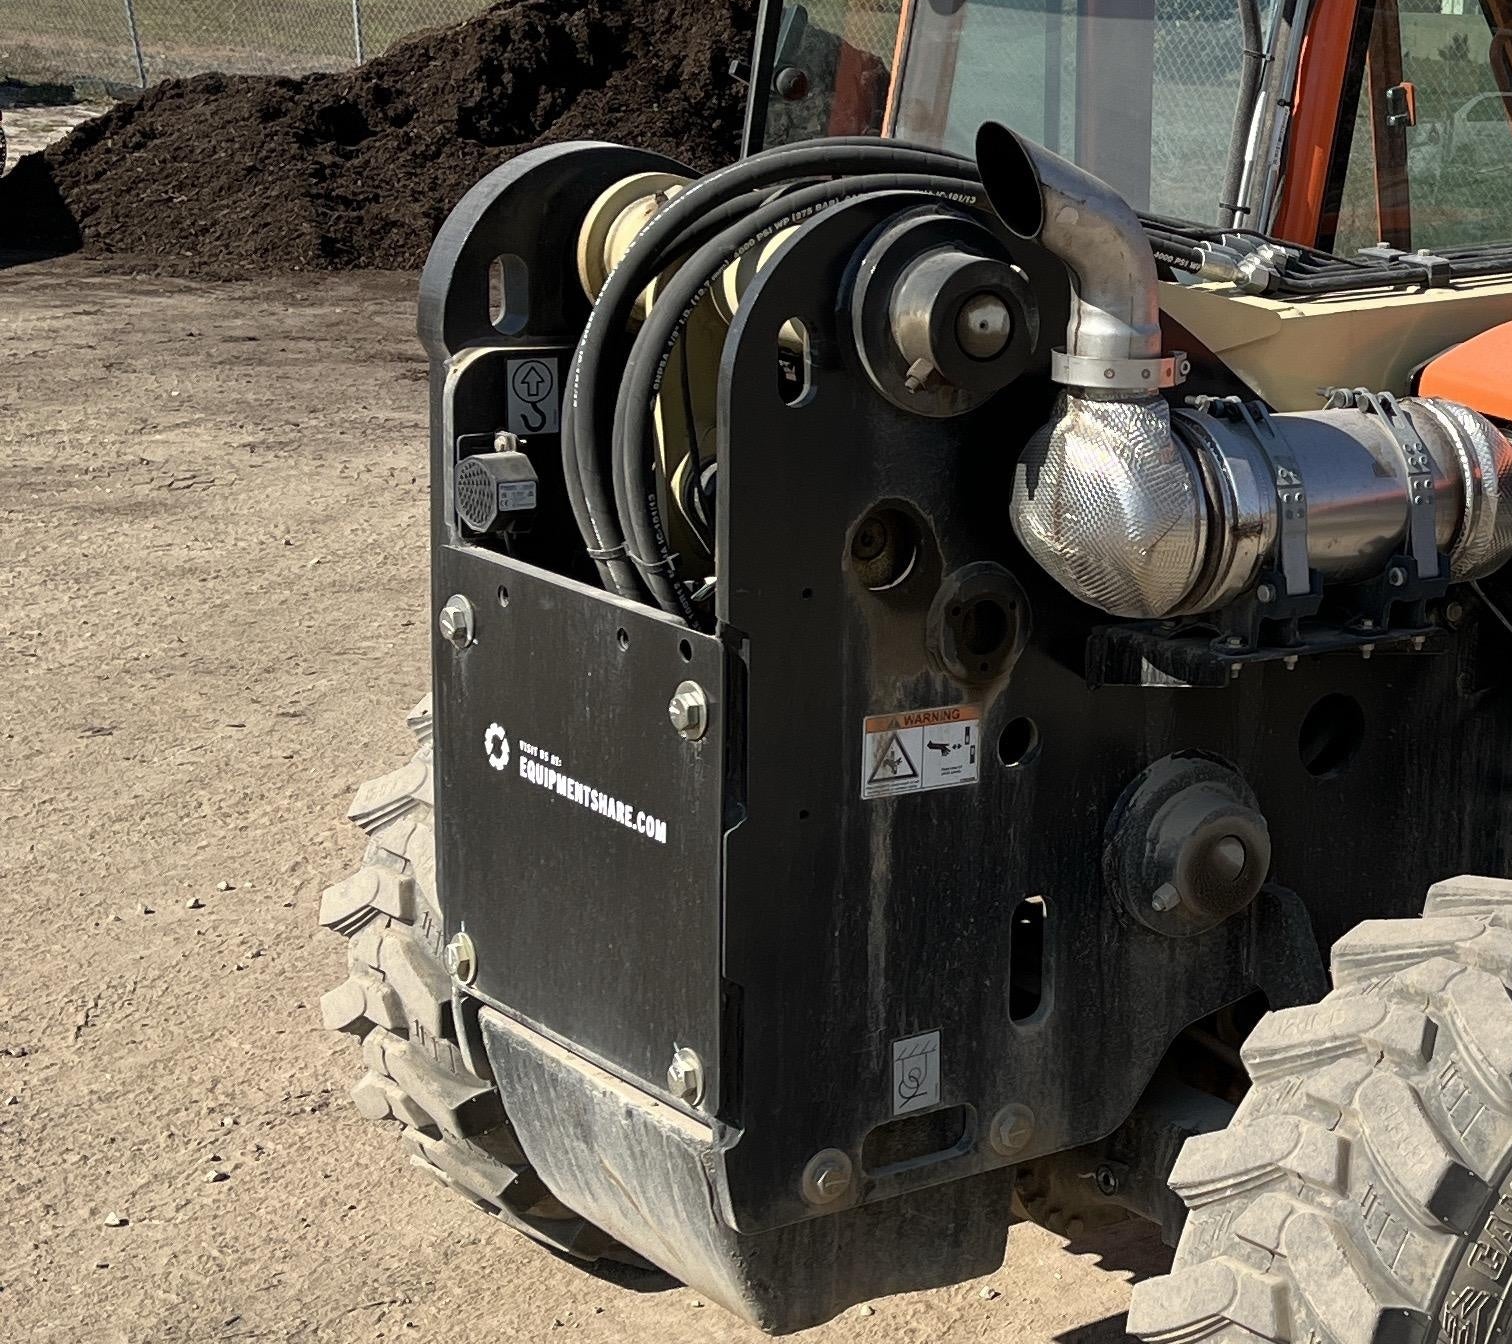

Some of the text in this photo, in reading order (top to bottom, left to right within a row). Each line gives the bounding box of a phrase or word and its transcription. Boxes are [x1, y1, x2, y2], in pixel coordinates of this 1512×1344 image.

[903, 708, 961, 727] WARNING
[519, 740, 538, 757] VISIT
[539, 749, 549, 762] US
[519, 755, 667, 844] EQUIPMENTSHARE.COM
